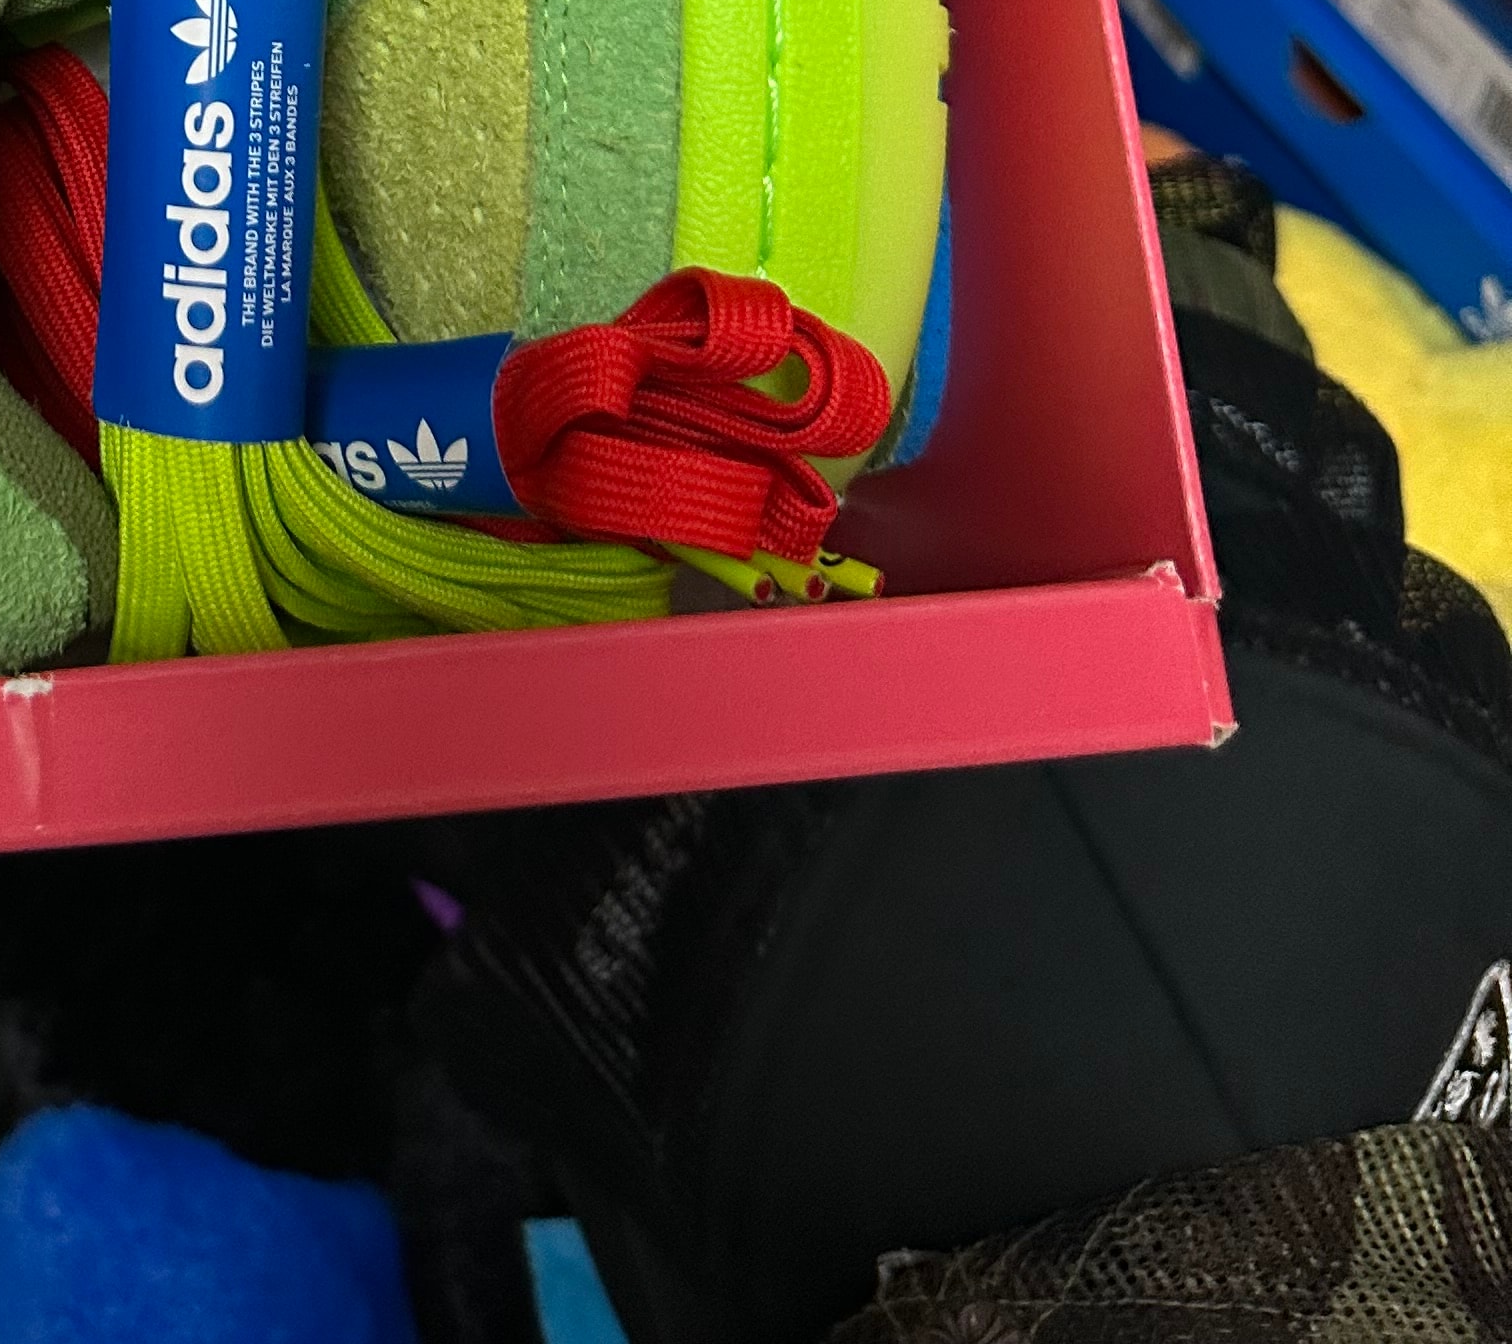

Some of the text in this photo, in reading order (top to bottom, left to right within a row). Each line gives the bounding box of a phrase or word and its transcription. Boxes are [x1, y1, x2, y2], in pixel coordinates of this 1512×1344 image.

[162, 100, 235, 405] adidas
[241, 60, 265, 328] THE BRAND WITH THE 3 STRIPES
[261, 41, 284, 349] DIE WELTMARKE MIT DEN 3 STREIFEN
[280, 84, 299, 303] LA MARQUE AUX 3 BANDES
